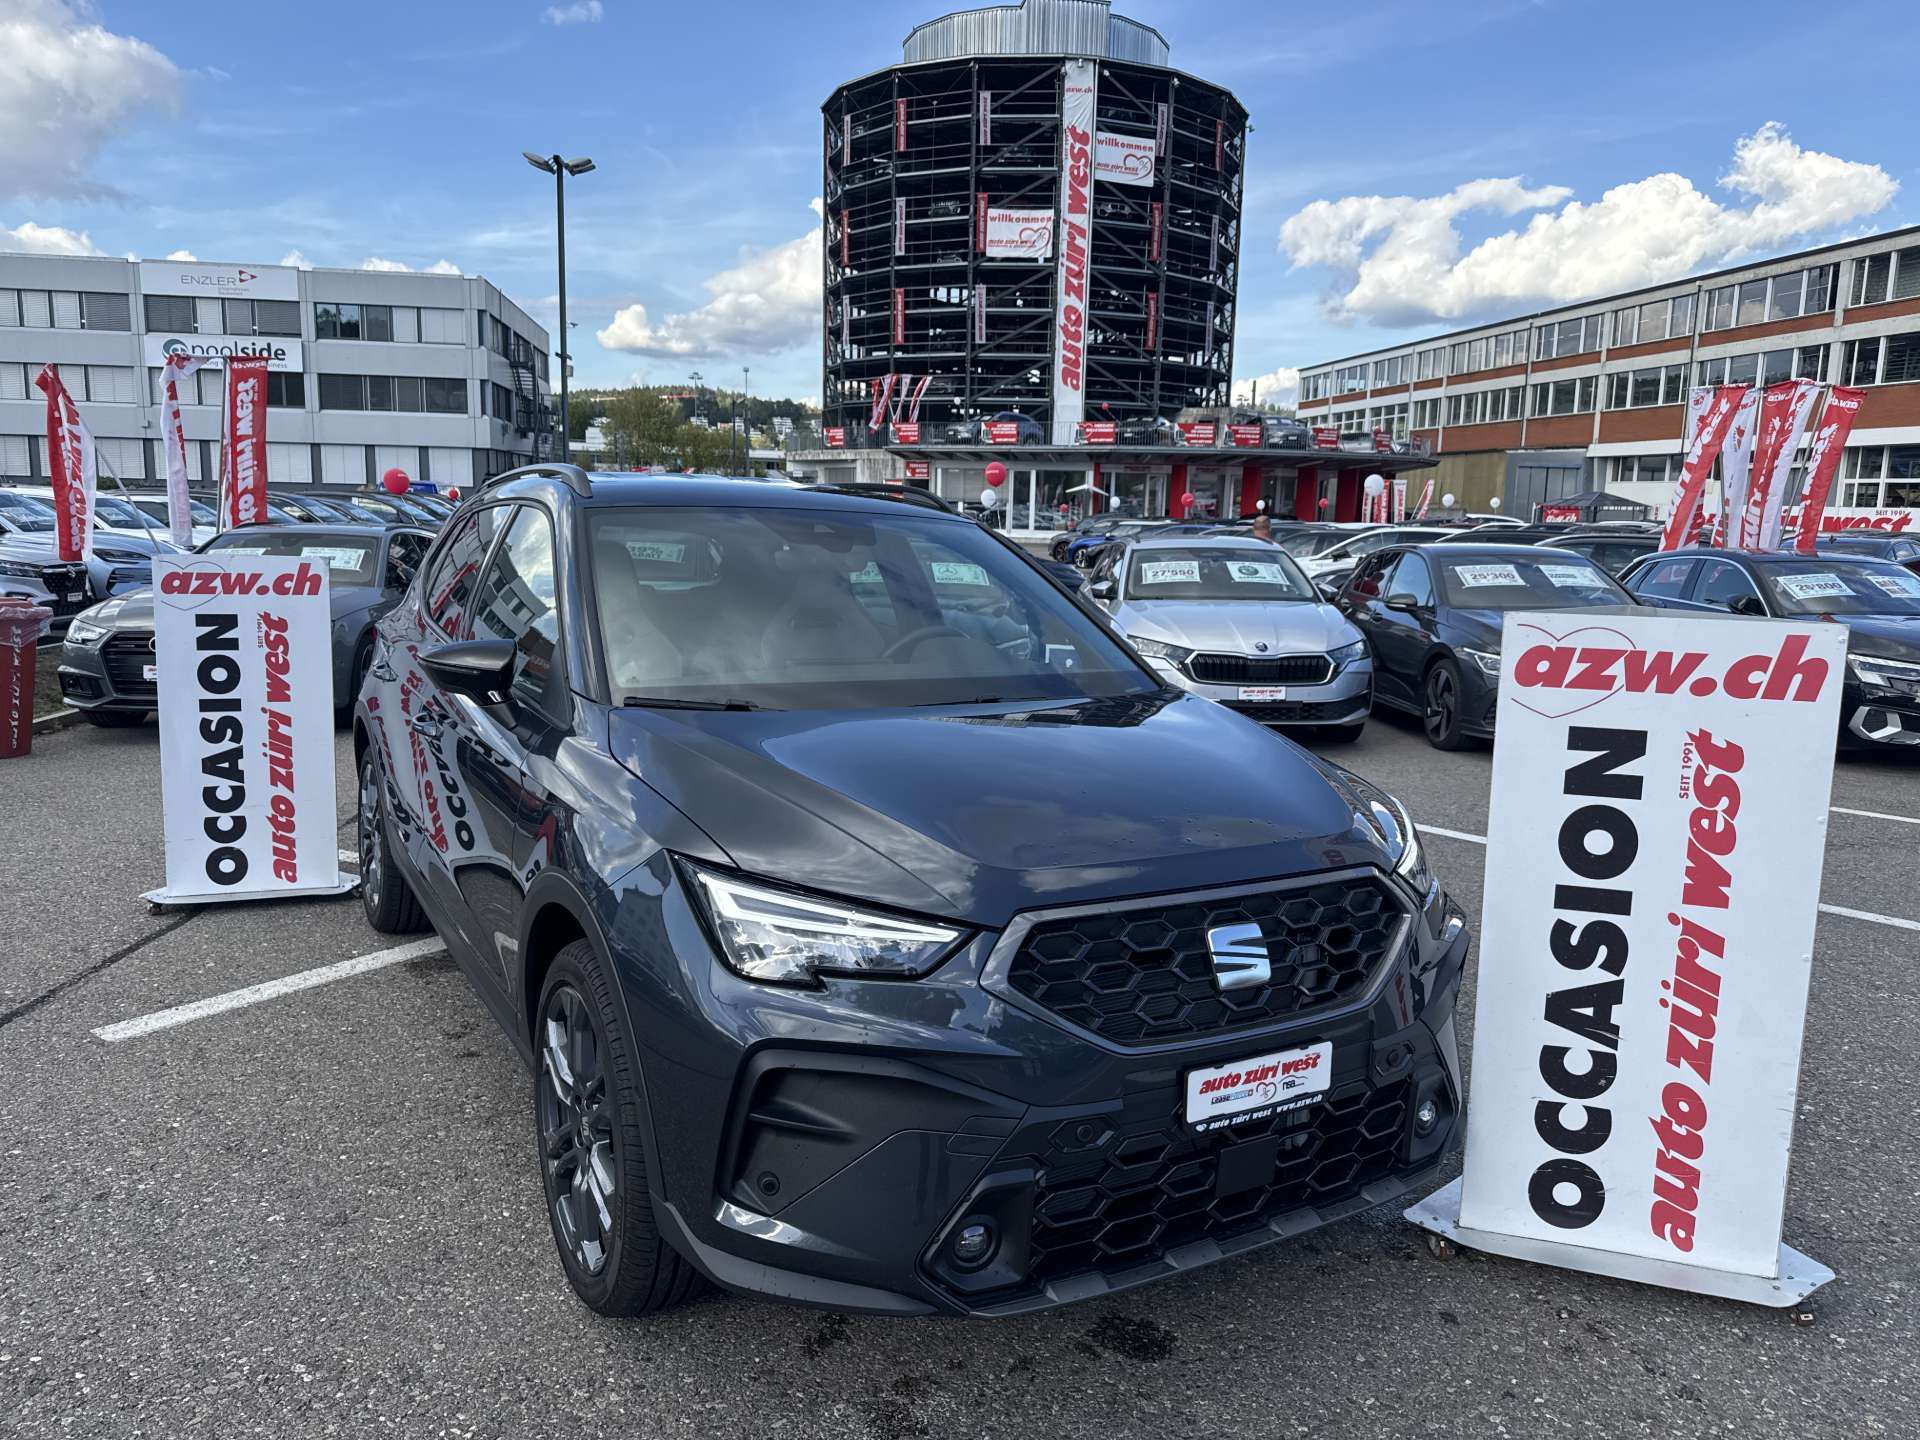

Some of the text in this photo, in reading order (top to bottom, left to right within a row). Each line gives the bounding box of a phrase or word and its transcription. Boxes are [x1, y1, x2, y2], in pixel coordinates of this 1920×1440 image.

[1097, 136, 1154, 153] willkommen
[181, 275, 237, 286] ENZLER
[1059, 124, 1090, 392] auto züri west
[161, 563, 322, 595] azw.ch
[1514, 635, 1828, 702] azw.ch
[195, 614, 249, 886] OCCASION
[261, 611, 298, 884] auto züri west
[1680, 741, 1694, 800] SEIT 1991
[1528, 726, 1648, 1229] OCCASION
[1648, 728, 1746, 1254] auto züri west
[1199, 1055, 1321, 1094] auto züri west
[1253, 1109, 1272, 1120] west
